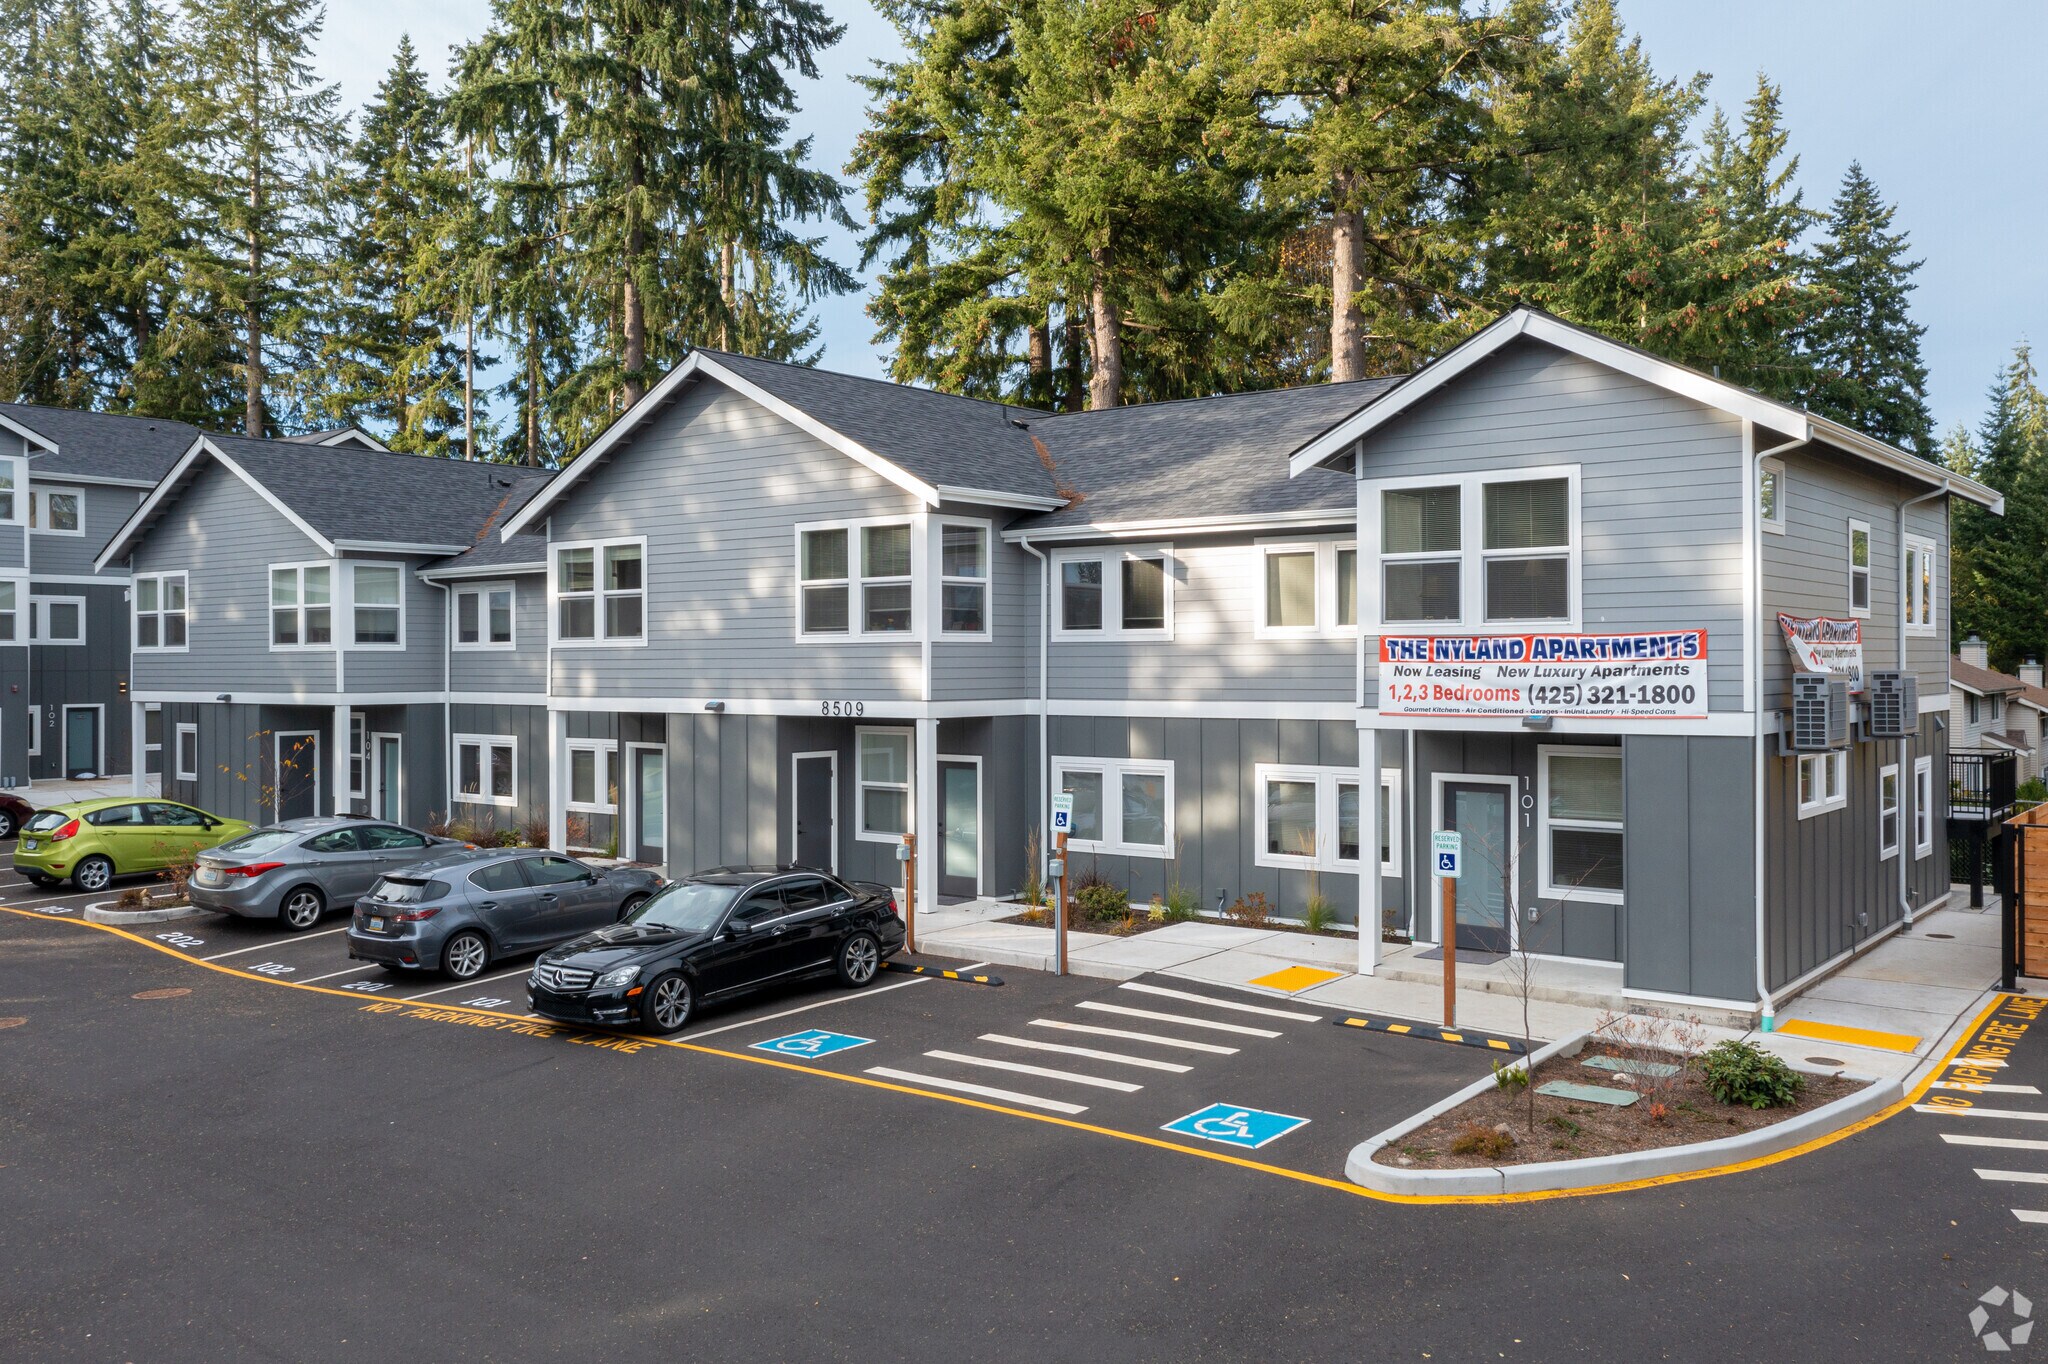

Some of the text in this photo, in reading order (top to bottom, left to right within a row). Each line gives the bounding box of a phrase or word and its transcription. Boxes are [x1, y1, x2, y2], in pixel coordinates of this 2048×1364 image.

[1387, 632, 1699, 661] THE NYLAND APARTMENTS
[1394, 664, 1690, 680] Now Leasing New Luxury Apartments
[1389, 684, 1696, 706] 1,2,3 Bedrooms (425) 321-1800
[48, 704, 56, 728] 102
[821, 700, 864, 717] 8509
[1521, 776, 1534, 827] 101
[1434, 834, 1460, 843] RESERVED
[156, 931, 205, 948] 202
[248, 961, 296, 975] 102
[341, 980, 394, 992] 201
[460, 997, 511, 1008] 101
[358, 1002, 658, 1054] NO PARKING FIRE LANE
[1978, 1020, 2029, 1046] FIRE
